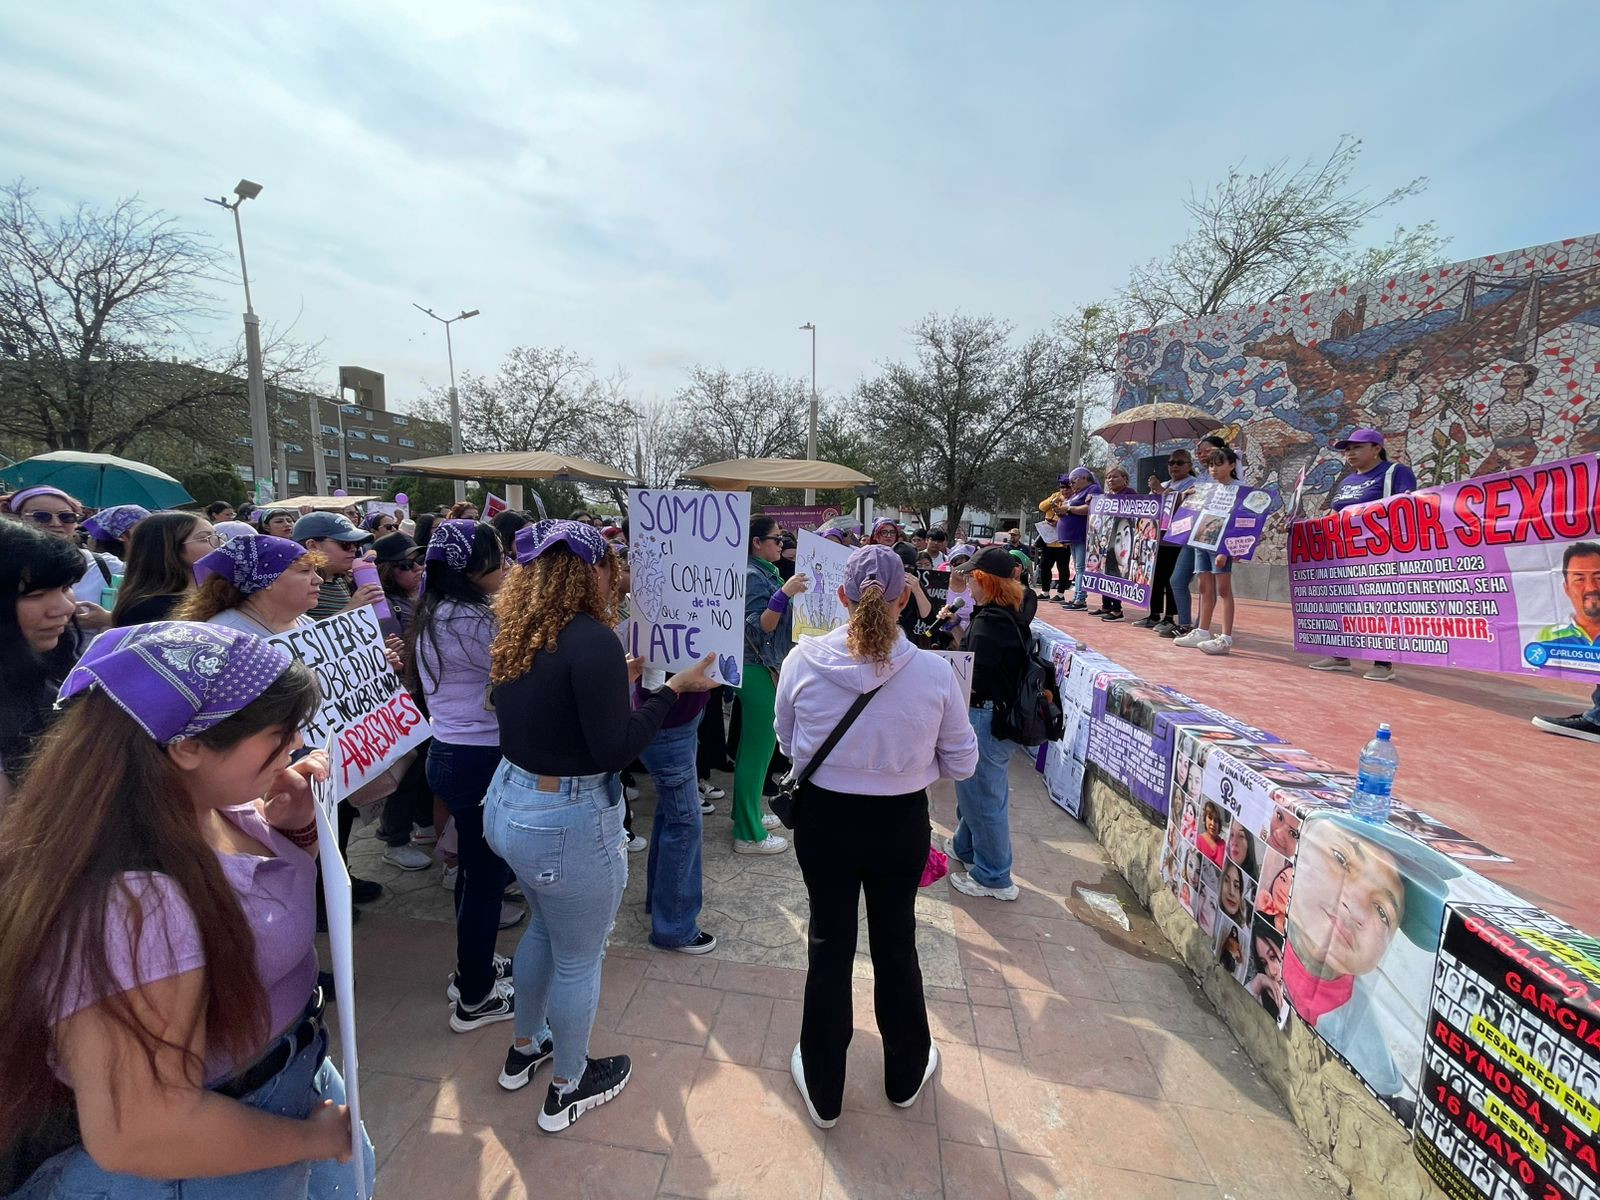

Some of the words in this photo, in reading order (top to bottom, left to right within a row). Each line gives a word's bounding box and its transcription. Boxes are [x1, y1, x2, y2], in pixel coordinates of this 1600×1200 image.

[638, 491, 741, 548] SOMOS
[1095, 499, 1103, 512] 8
[1104, 499, 1119, 513] DE
[1119, 499, 1159, 516] MARZO
[1290, 491, 1449, 563] AGRESOR
[671, 562, 744, 600] CORAZÓN
[1293, 569, 1315, 580] EXISTE
[1329, 565, 1367, 579] DENUNCIA
[1369, 562, 1397, 577] DESDE
[1399, 559, 1433, 574] MARZO
[1435, 558, 1455, 572] DEL
[1456, 556, 1485, 571] 2023
[692, 597, 704, 608] de
[707, 598, 720, 607] las
[1082, 574, 1096, 590] NI
[1098, 577, 1122, 595] UNA
[1122, 584, 1145, 603] MÁS
[1294, 586, 1308, 597] POR
[1308, 585, 1329, 597] ABUSO
[1329, 583, 1358, 597] SEXUAL
[1359, 582, 1405, 596] AGRAVADO
[1407, 580, 1421, 594] EN
[1423, 579, 1474, 595] REYNOSA,
[1475, 577, 1490, 593] SE
[1490, 577, 1508, 592] HA
[662, 605, 680, 620] QUE
[687, 611, 699, 622] YA
[711, 609, 732, 630] NO
[1296, 602, 1319, 613] CITADO
[1319, 603, 1325, 613] A
[1325, 601, 1362, 614] AUDIENCIA
[1364, 602, 1375, 614] EN
[1376, 602, 1383, 614] 2
[1384, 601, 1438, 615] OCASIONES
[1438, 601, 1446, 614] Y
[1448, 601, 1464, 615] NO
[1466, 601, 1480, 615] SE
[1482, 600, 1499, 615] HA
[633, 621, 701, 664] LATE
[1299, 632, 1355, 647] PRESUNTAMENTE
[1355, 635, 1367, 649] SE
[1367, 636, 1385, 650] FUE
[1385, 637, 1397, 650] DE
[1398, 638, 1410, 651] LA
[1411, 638, 1449, 653] CIUDAD
[1343, 615, 1388, 635] AYUDA
[1390, 616, 1402, 636] A
[1404, 616, 1494, 642] DIFUNDIR,
[1550, 648, 1583, 658] CARLOS
[314, 645, 388, 701] OBIERNO
[337, 693, 421, 789] AGRESORES
[1225, 765, 1238, 781] UNA
[1464, 917, 1589, 999] GERARDO
[1434, 1021, 1551, 1134] REYNOSA,
[1476, 1022, 1560, 1096] DESAPARECI
[1563, 1096, 1593, 1122] EN:
[1436, 1085, 1462, 1115] 16
[1465, 1111, 1535, 1185] MAYO
[1489, 1103, 1540, 1154] DESDE:
